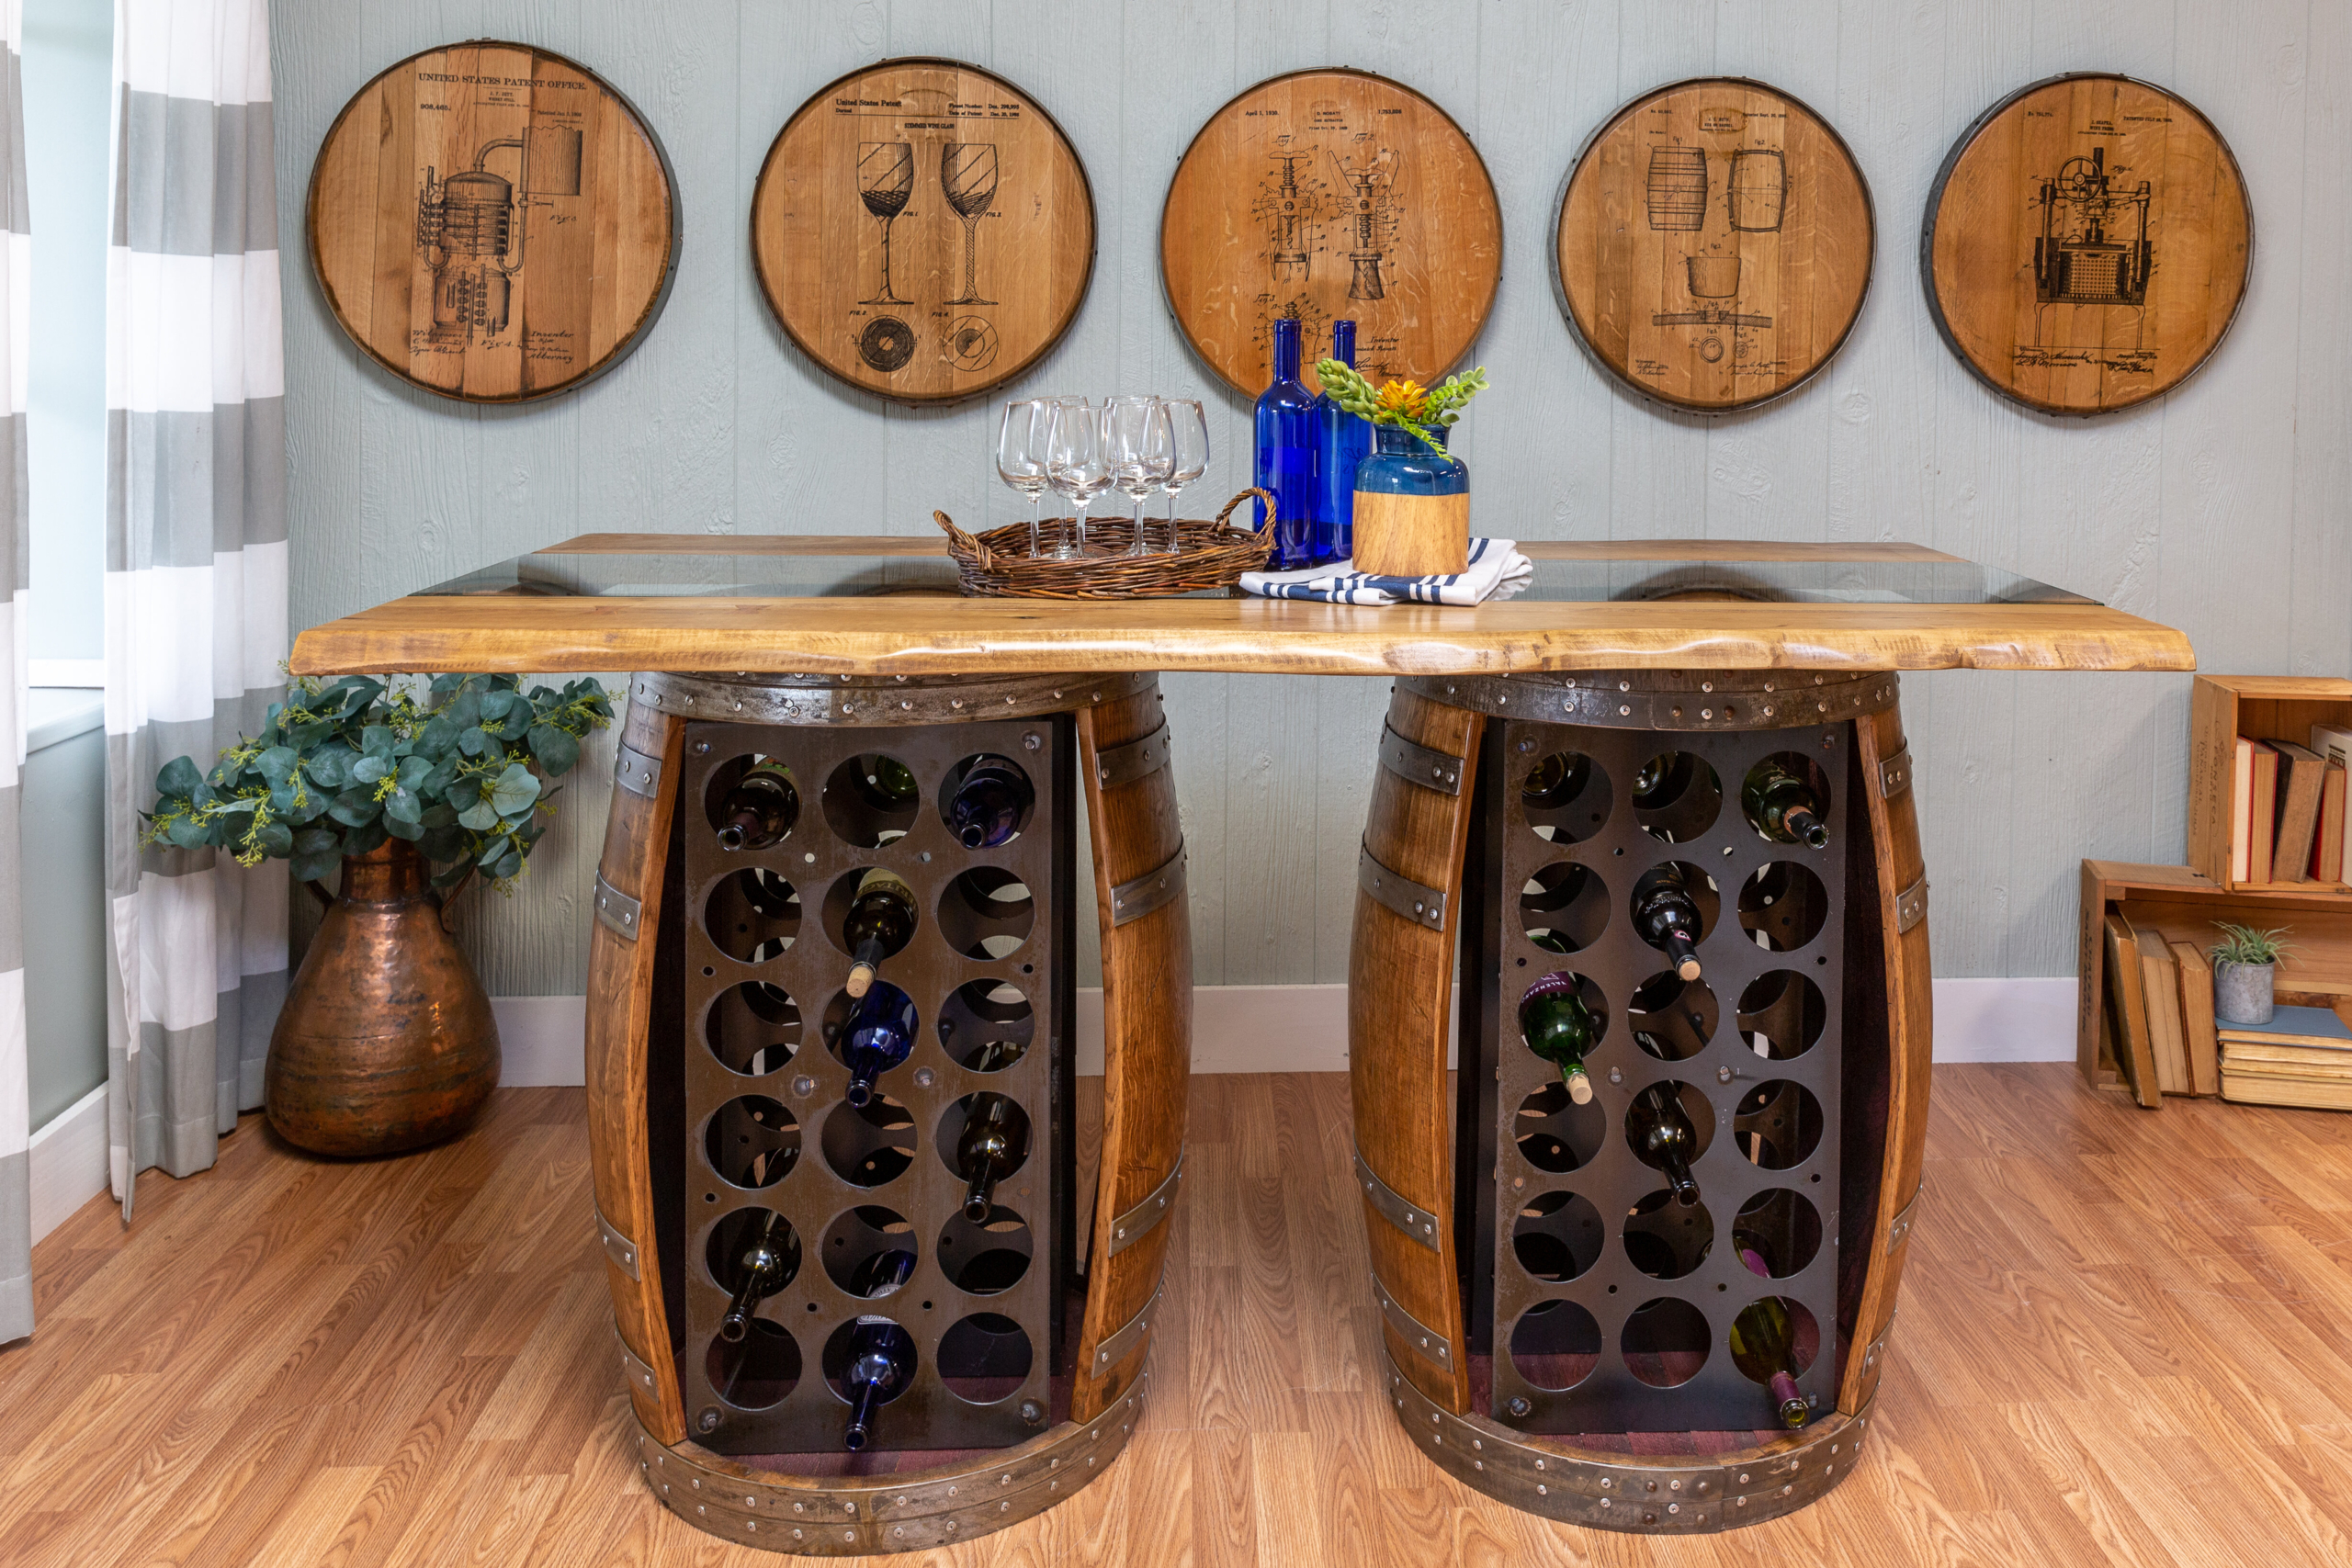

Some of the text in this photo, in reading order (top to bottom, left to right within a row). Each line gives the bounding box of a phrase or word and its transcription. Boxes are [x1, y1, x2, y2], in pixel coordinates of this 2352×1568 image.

[418, 73, 587, 90] UNITED STATES PATENT OFFICE.
[835, 98, 857, 107] United
[880, 99, 902, 107] Patent
